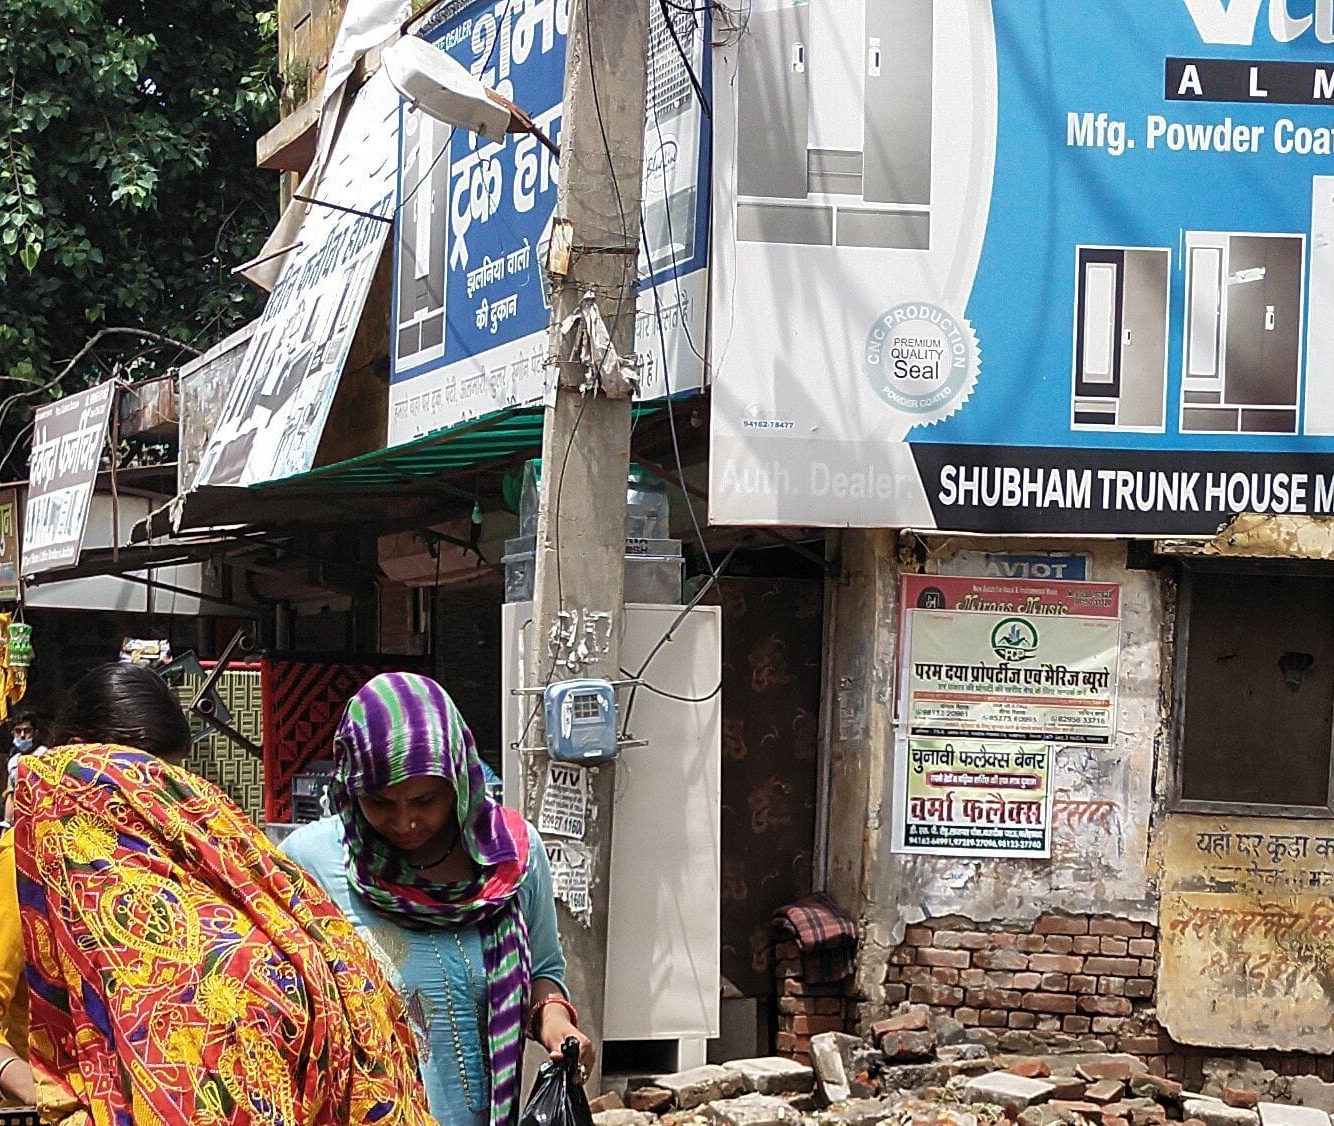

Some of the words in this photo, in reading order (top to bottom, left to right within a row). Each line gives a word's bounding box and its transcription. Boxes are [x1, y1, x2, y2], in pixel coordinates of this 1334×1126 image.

[1067, 112, 1135, 156] Mfg.
[1146, 114, 1265, 155] Powder
[489, 294, 518, 334] दुकान
[867, 328, 886, 365] CNC
[883, 305, 966, 369] PRODUCTION
[893, 337, 942, 348] PREMIUM
[890, 348, 944, 361] QUALITY
[893, 360, 939, 380] Seal
[720, 460, 796, 498] Auth.
[809, 462, 915, 502] Dealer:
[938, 464, 1092, 511] SHUBHAM
[1097, 469, 1201, 513] TRUNK
[1204, 472, 1306, 514] HOUSE
[1017, 596, 1068, 616] Music
[914, 663, 943, 682] परम
[945, 664, 968, 682] दया
[1045, 664, 1079, 687] मैरिज
[912, 744, 955, 774] चुनावी
[958, 745, 1010, 769] फलैक्स
[551, 768, 581, 787] VIV
[910, 791, 956, 823] वर्मा
[962, 792, 1043, 826] फलैक्स
